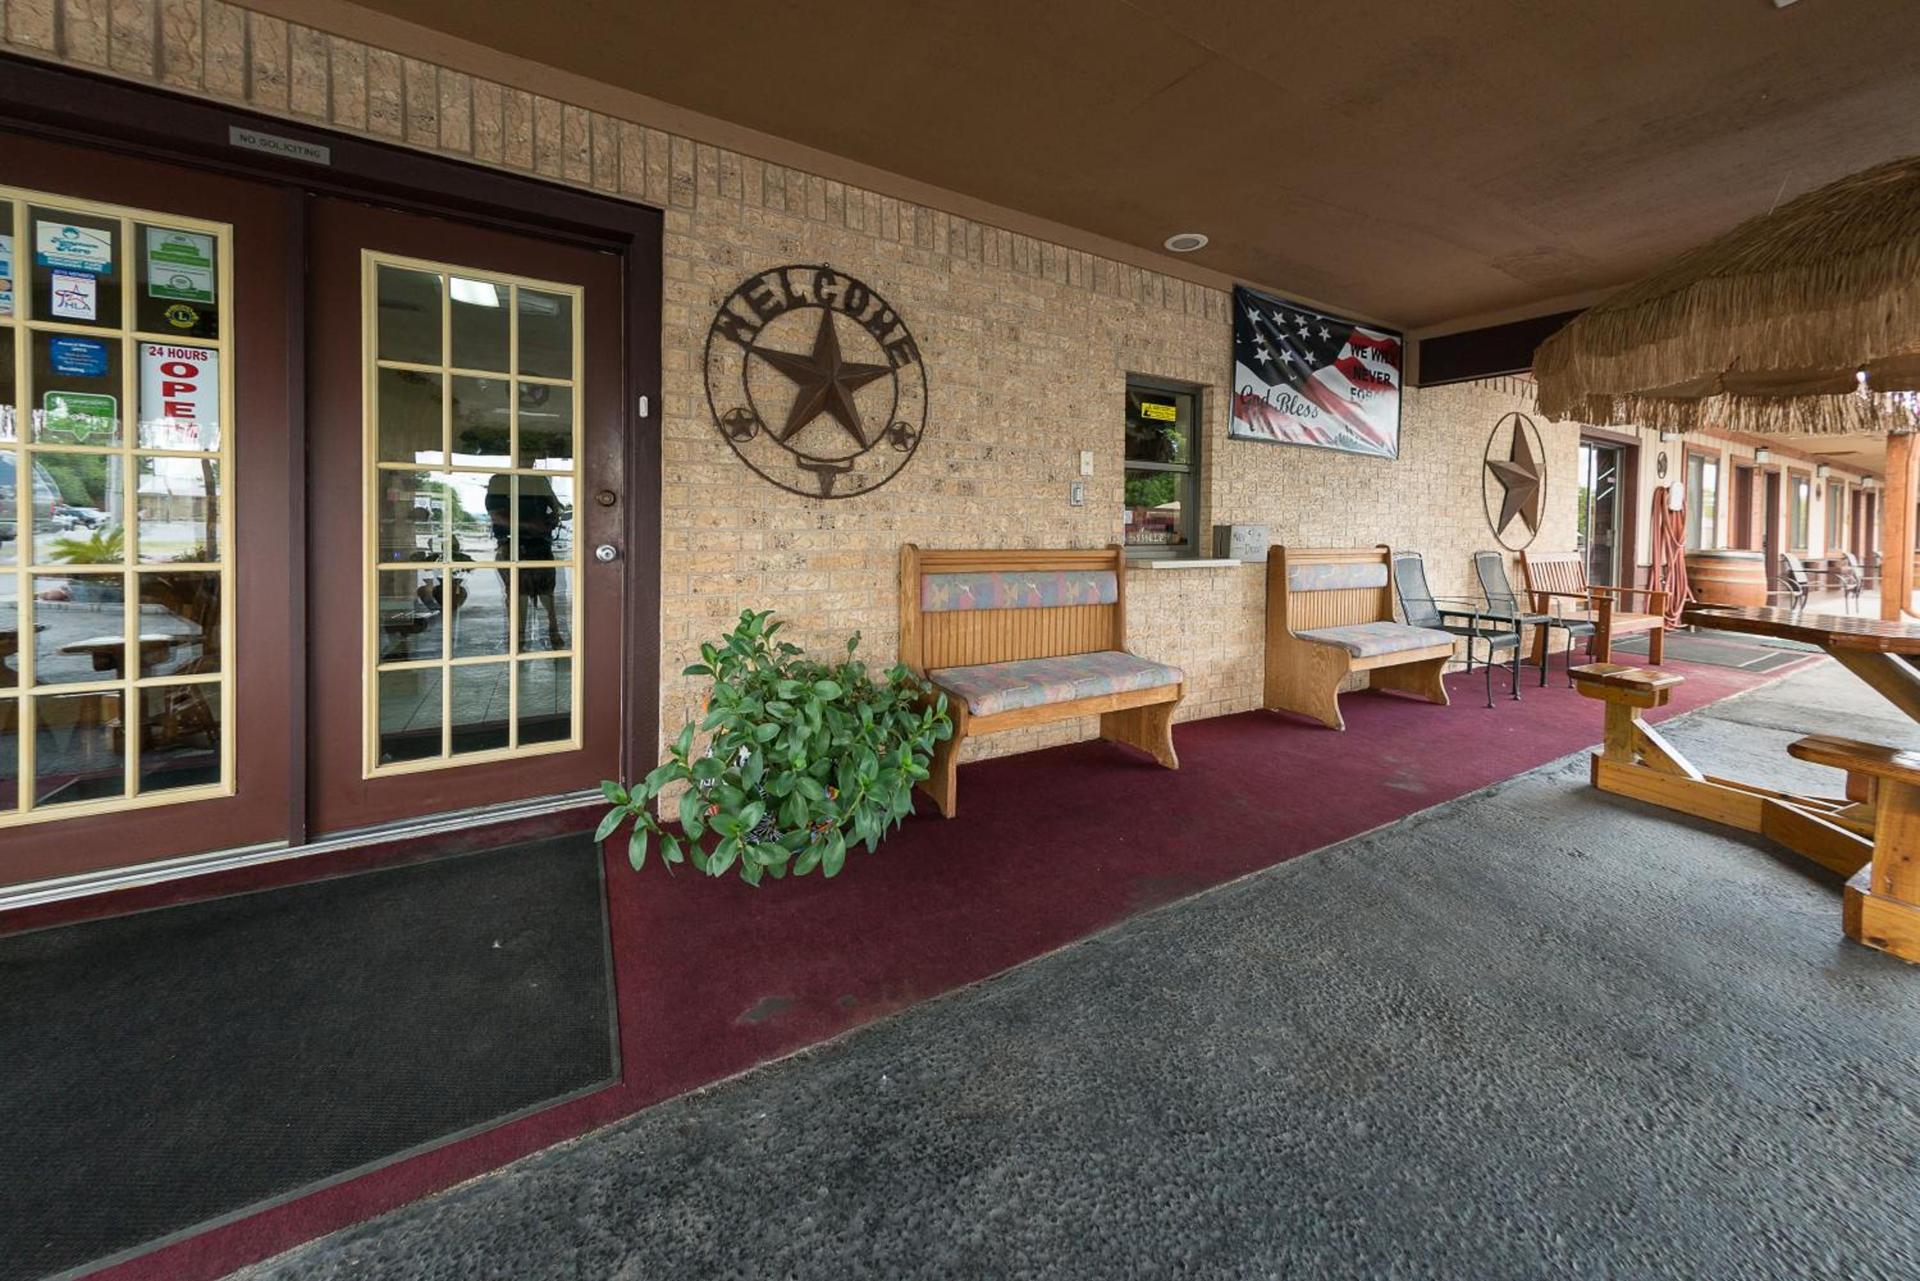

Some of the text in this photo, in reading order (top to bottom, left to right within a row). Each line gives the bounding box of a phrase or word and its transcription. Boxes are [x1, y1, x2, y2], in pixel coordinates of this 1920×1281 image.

[240, 134, 320, 158] NO SOLICITING
[710, 267, 920, 372] WELCOME
[149, 346, 208, 361] 24 HOURS
[1351, 344, 1367, 359] WE
[1353, 364, 1390, 385] NEVER
[160, 361, 199, 438] OPE
[1276, 393, 1318, 418] Bless
